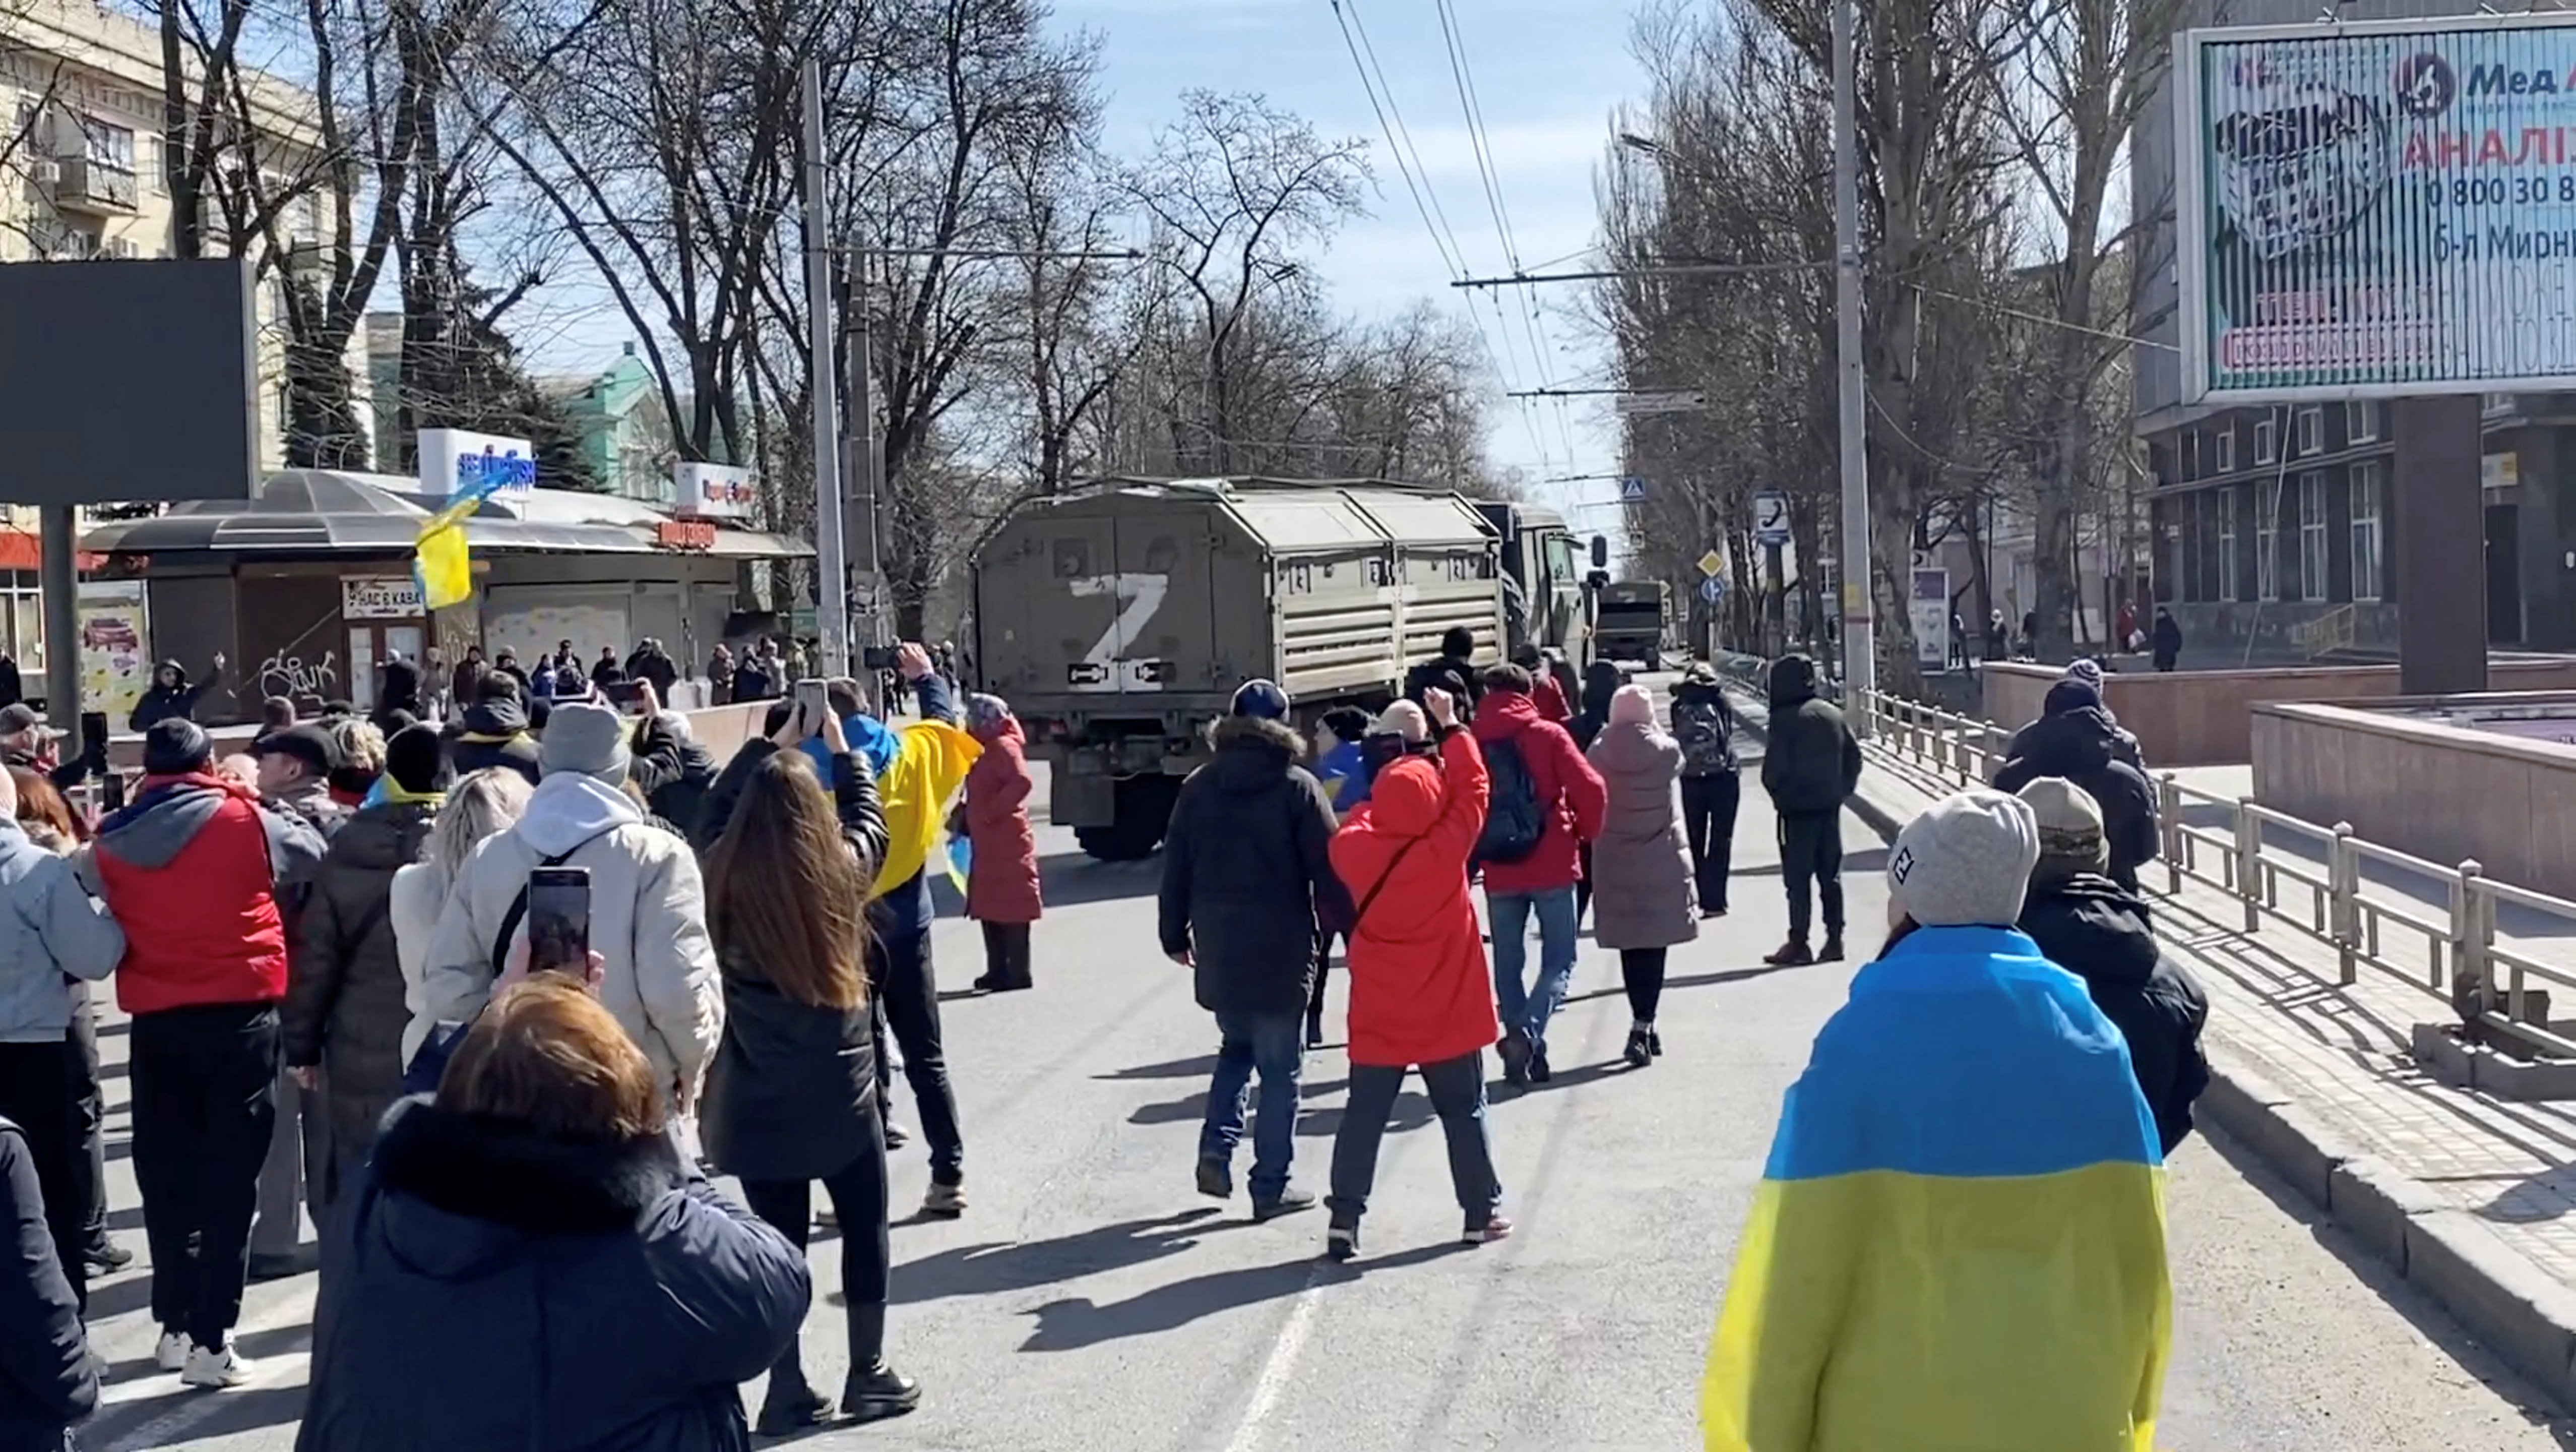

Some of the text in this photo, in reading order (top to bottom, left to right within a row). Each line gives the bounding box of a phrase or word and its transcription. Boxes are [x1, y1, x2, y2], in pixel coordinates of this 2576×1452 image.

[2404, 127, 2576, 169] АНАЛІ
[2429, 180, 2442, 208] 0
[2454, 177, 2505, 206] 800
[2515, 176, 2548, 204] 30
[1068, 573, 1169, 692] Z
